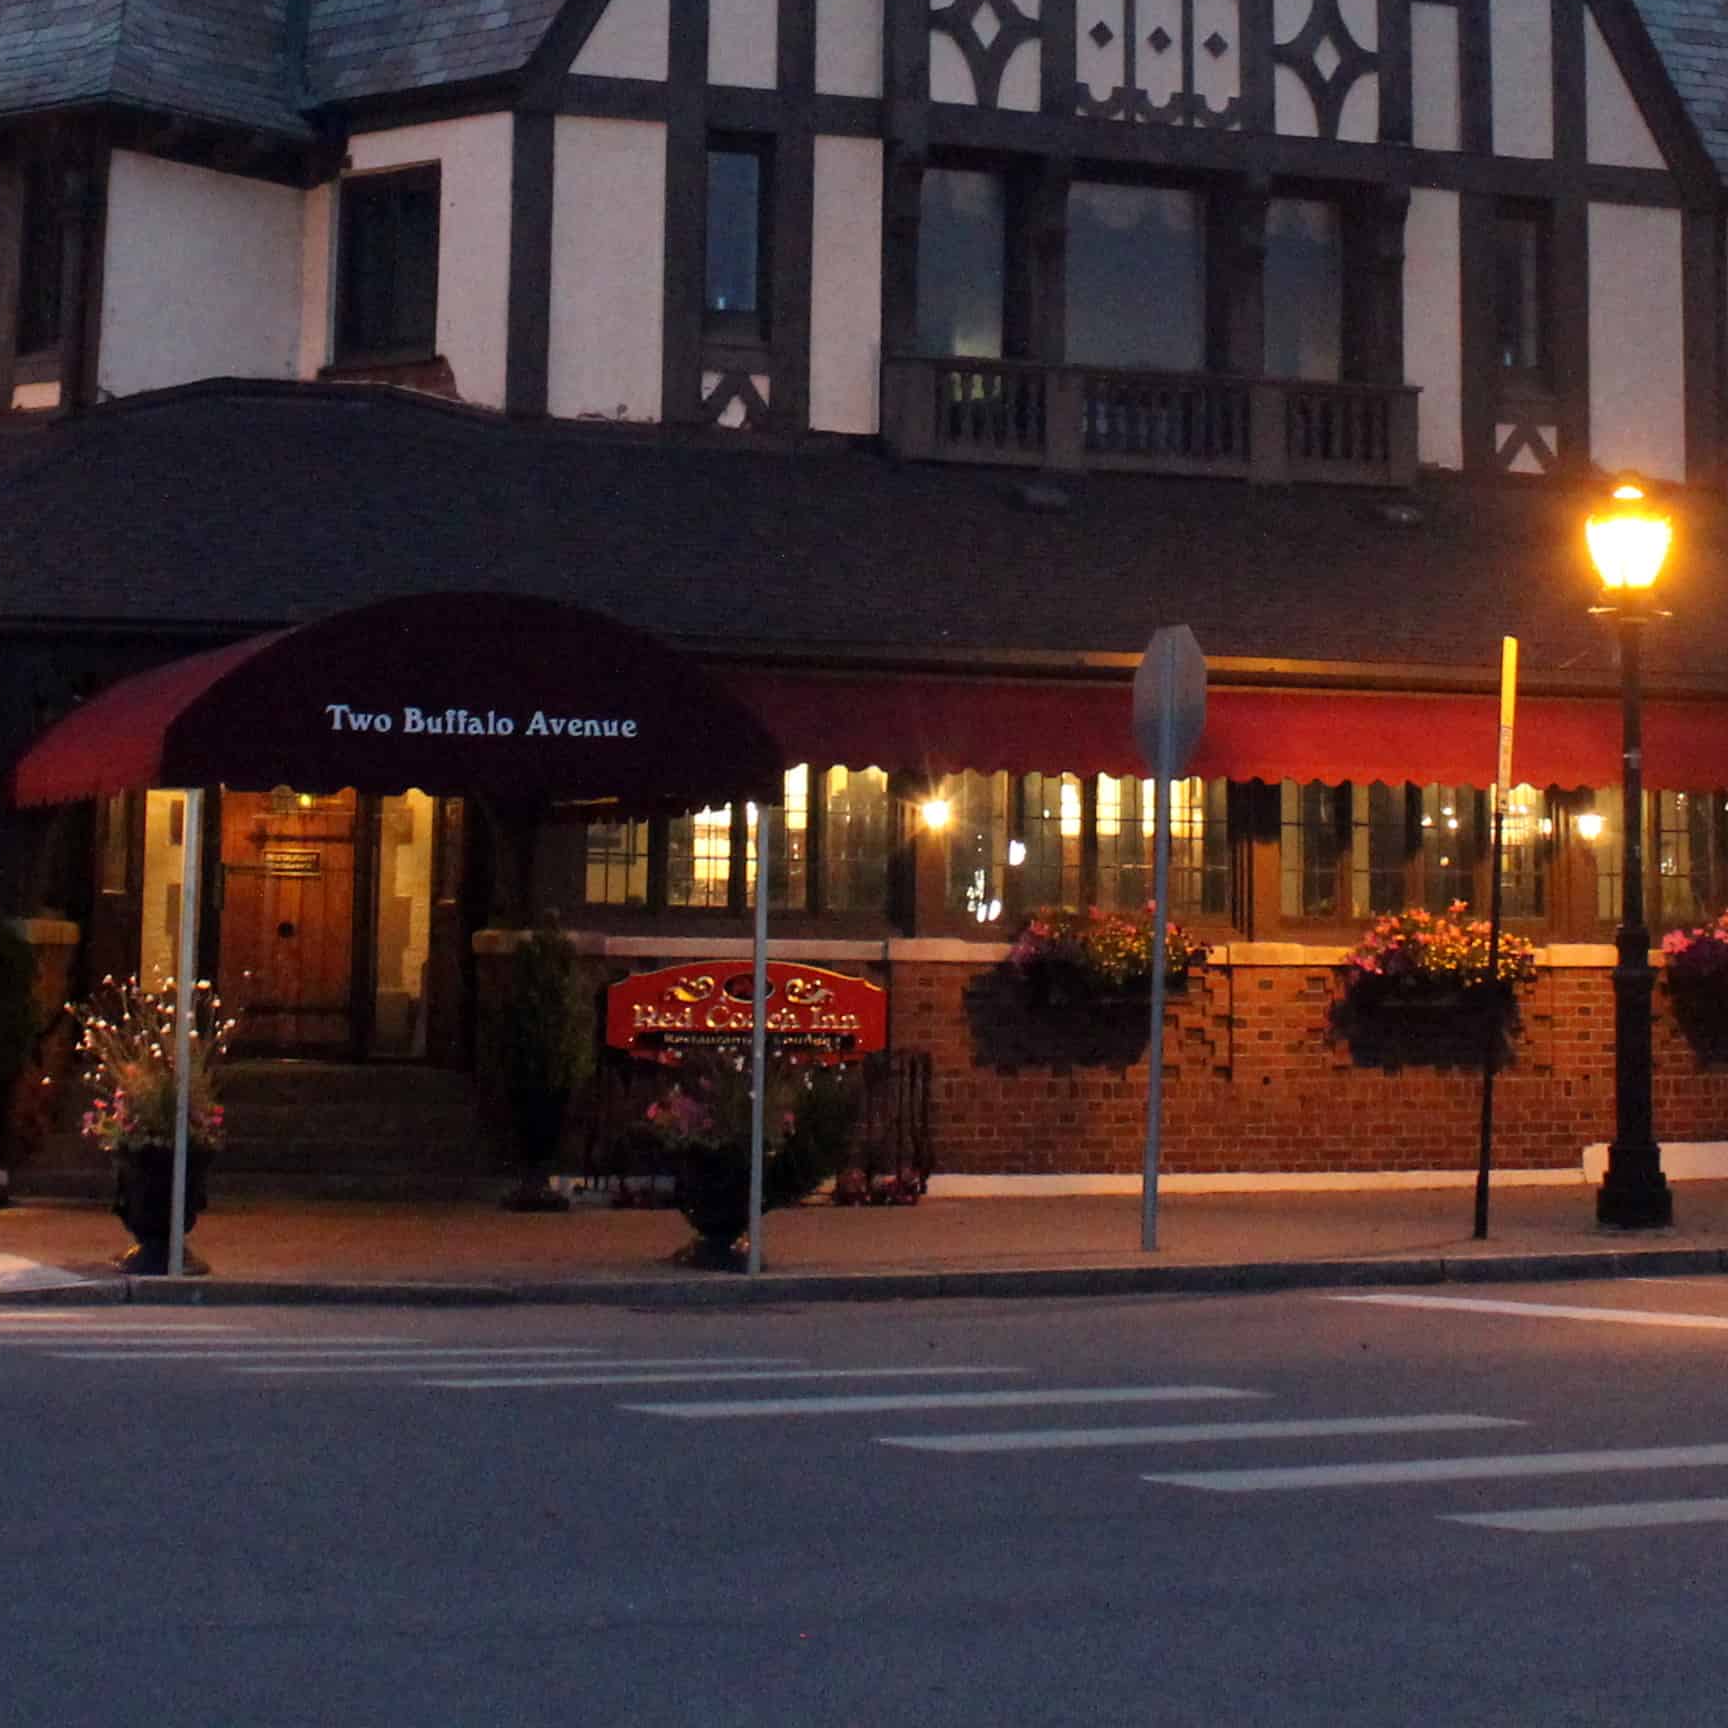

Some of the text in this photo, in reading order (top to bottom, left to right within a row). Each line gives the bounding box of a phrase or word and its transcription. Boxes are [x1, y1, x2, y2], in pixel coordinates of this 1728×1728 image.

[325, 703, 639, 738] Two Buffalo Avenue
[632, 1003, 693, 1029] Red
[810, 1006, 863, 1030] Inn
